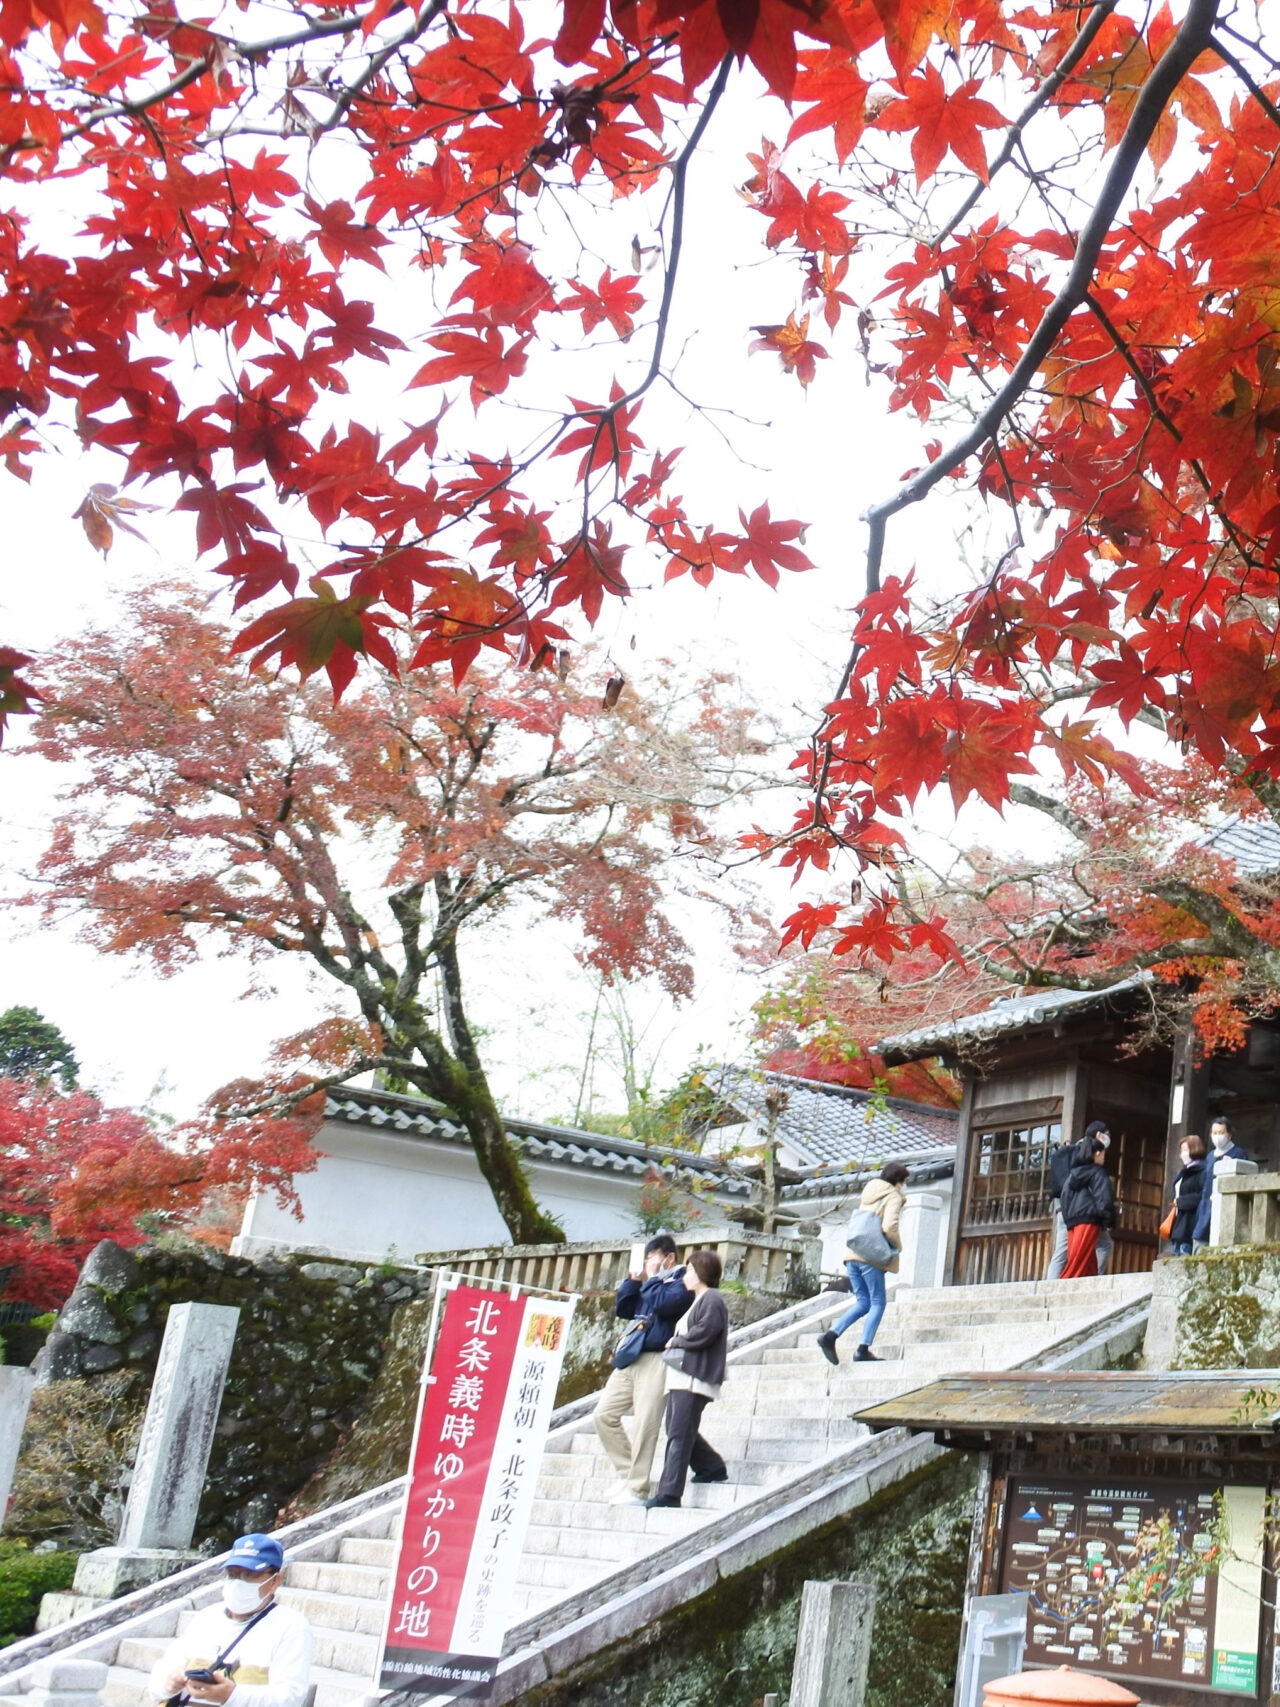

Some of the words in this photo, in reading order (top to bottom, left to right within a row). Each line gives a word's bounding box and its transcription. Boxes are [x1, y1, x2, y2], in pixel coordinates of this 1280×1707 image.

[393, 1300, 501, 1638] 北条義時ゆかりの地
[468, 1359, 546, 1644] 源頼朝・北条政子の史跡を巡る
